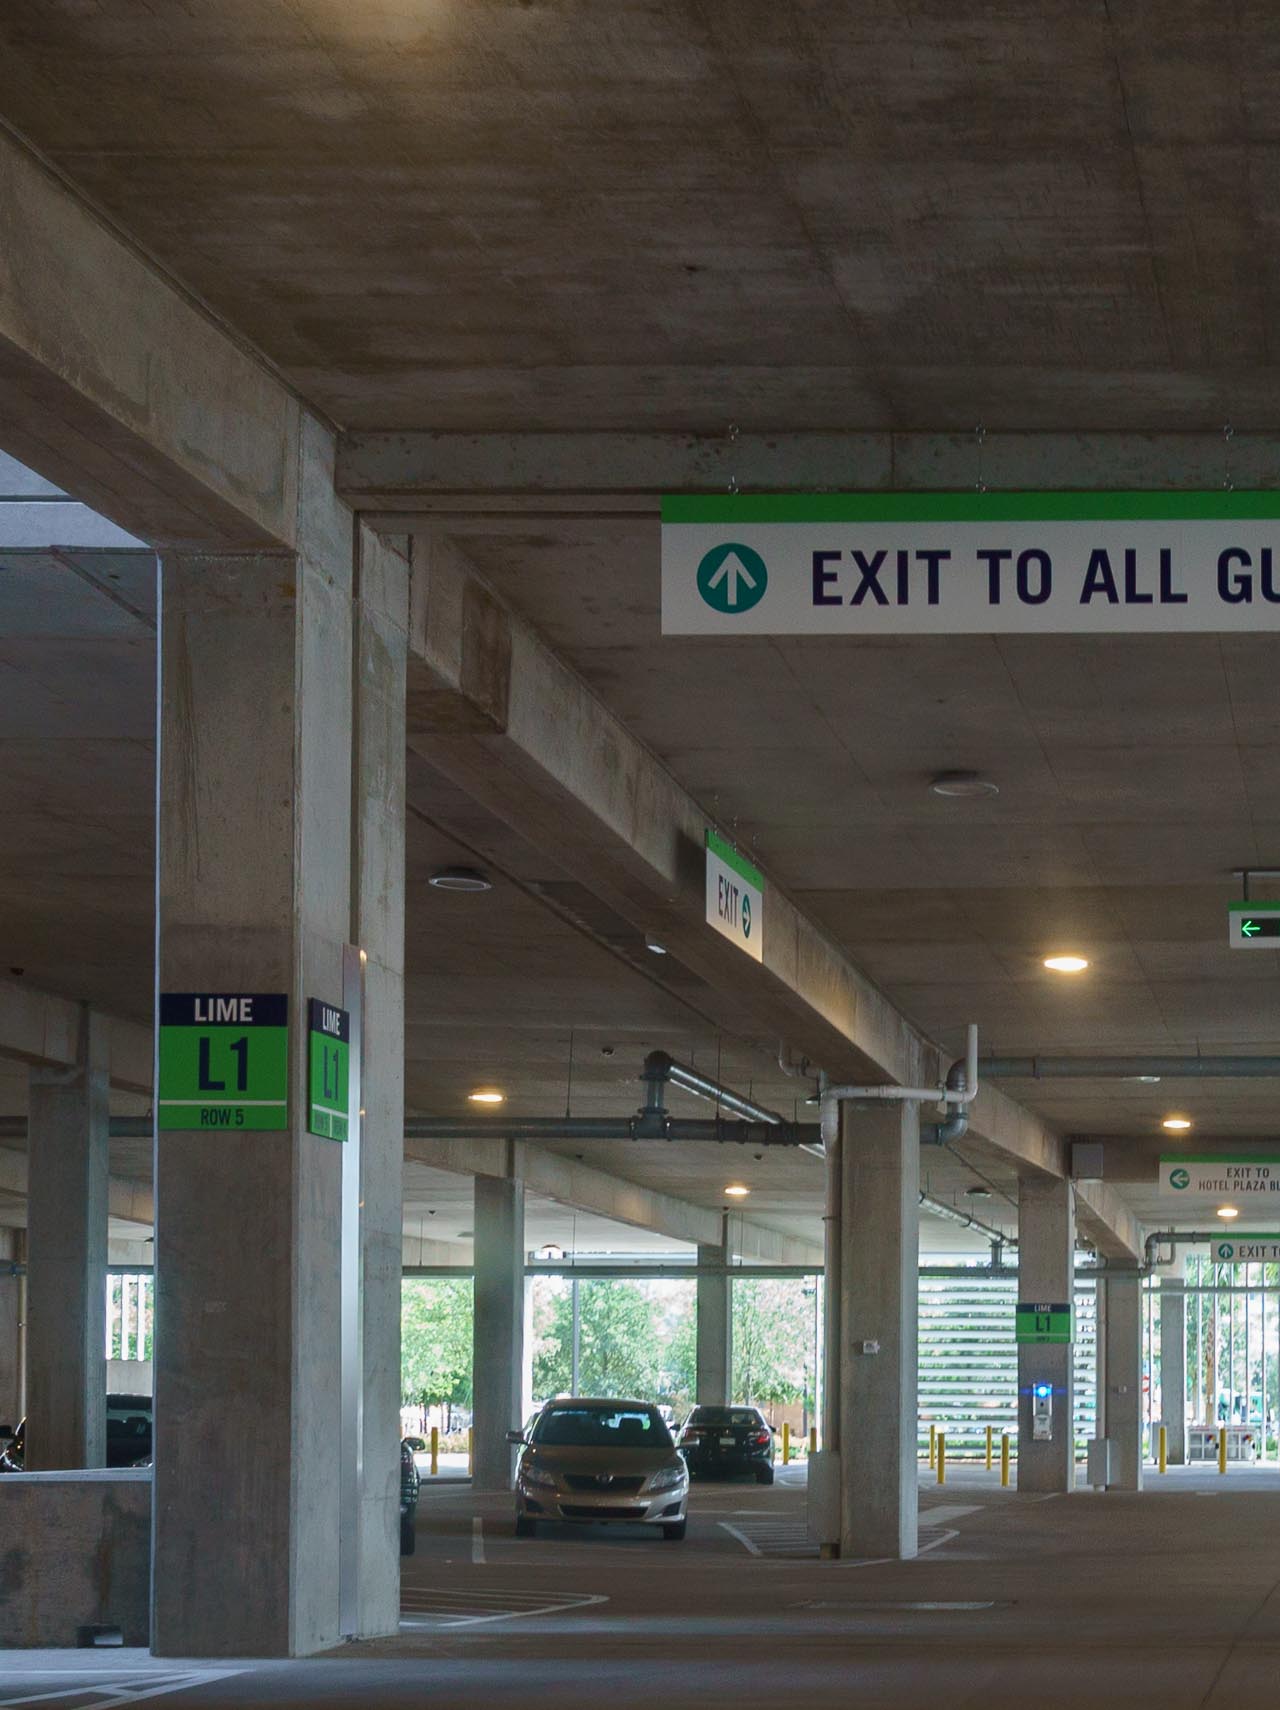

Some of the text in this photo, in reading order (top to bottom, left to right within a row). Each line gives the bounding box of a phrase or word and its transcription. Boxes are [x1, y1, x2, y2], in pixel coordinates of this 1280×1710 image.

[813, 548, 952, 606] EXIT
[976, 548, 1052, 605] TO
[1079, 548, 1188, 604] ALL
[718, 873, 739, 928] EXIT
[194, 998, 253, 1022] LIME
[322, 1007, 341, 1036] LIME
[198, 1036, 248, 1091] L1
[323, 1045, 339, 1101] L1
[201, 1109, 244, 1126] ROW 5
[1226, 1167, 1270, 1179] EXIT TO
[1199, 1179, 1230, 1191] HOTEL
[1233, 1180, 1266, 1192] PLAZA
[1239, 1245, 1267, 1258] EXIT
[1034, 1304, 1052, 1312] LIME
[1035, 1315, 1051, 1331] L1
